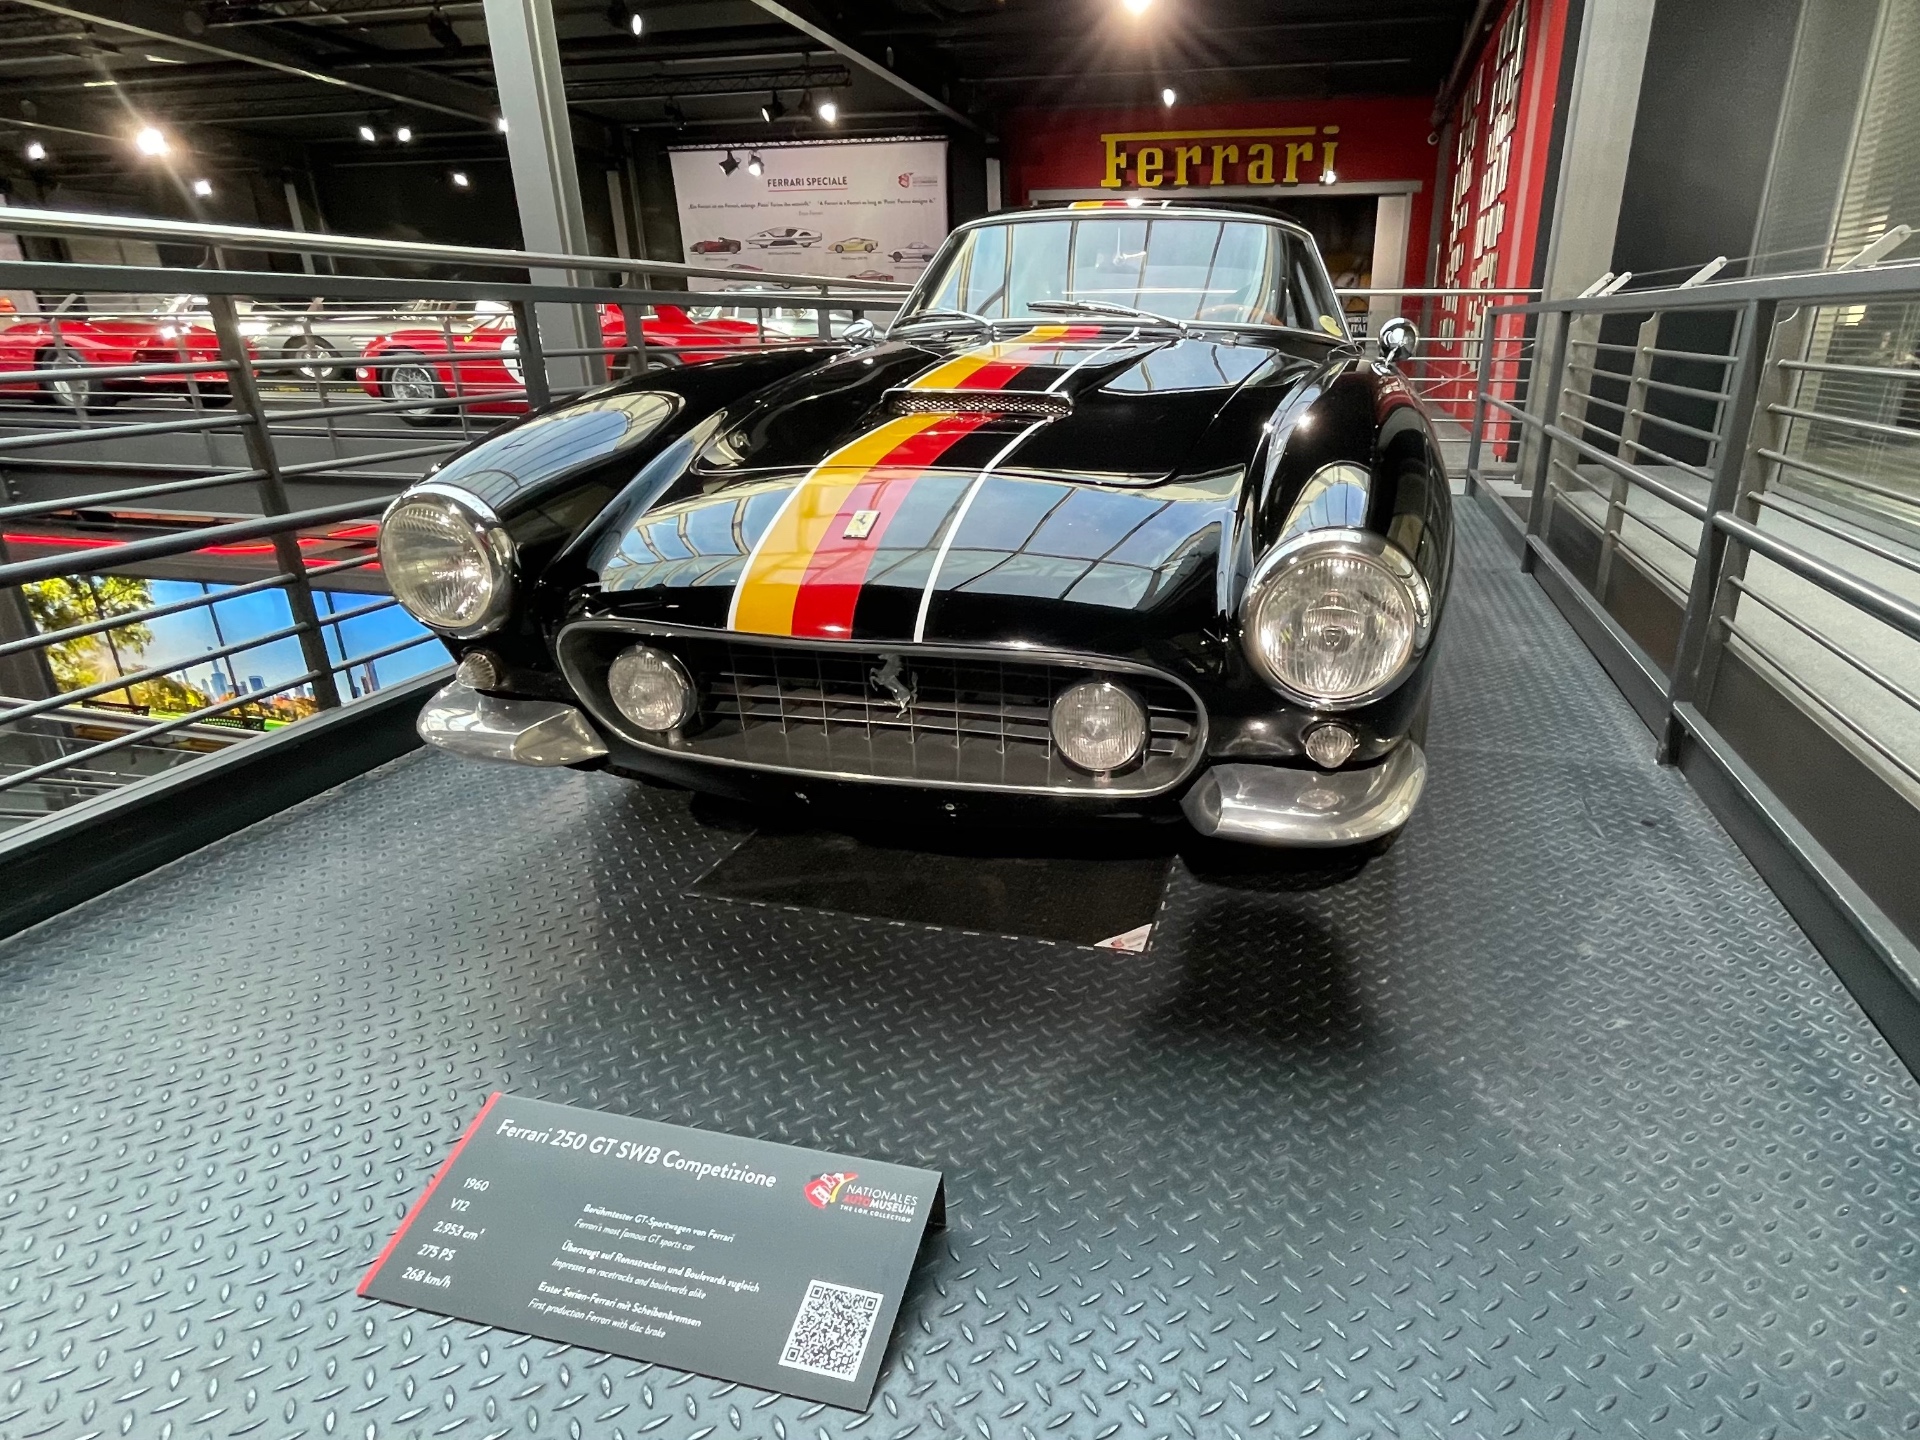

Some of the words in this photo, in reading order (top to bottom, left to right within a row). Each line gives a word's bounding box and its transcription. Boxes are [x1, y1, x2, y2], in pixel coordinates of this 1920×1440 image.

[1100, 125, 1340, 188] Ferrari
[767, 178, 805, 188] FERRARI
[806, 176, 848, 186] SPECIALE
[496, 1119, 553, 1144] Ferrari
[550, 1129, 588, 1150] 250
[589, 1136, 618, 1156] GT
[616, 1141, 661, 1165] SWB
[662, 1150, 777, 1188] Competizione
[463, 1177, 490, 1192] 1960
[846, 1184, 918, 1206] NATIONALES
[450, 1198, 471, 1212] V12
[840, 1204, 853, 1213] THE
[869, 1210, 912, 1223] COLLECTION
[432, 1220, 464, 1237] 2.953
[583, 1203, 634, 1222] Berühmtester
[634, 1213, 692, 1235] GT-Sportwagen
[692, 1228, 707, 1237] von
[707, 1228, 736, 1243] Ferrari
[603, 1226, 621, 1237] most
[618, 1227, 647, 1242] famous
[648, 1233, 662, 1244] GT
[659, 1238, 682, 1249] sports
[682, 1243, 696, 1252] car
[417, 1244, 440, 1258] 275
[438, 1248, 457, 1261] PS
[402, 1267, 425, 1282] 268
[423, 1271, 451, 1289] km/h
[561, 1239, 600, 1260] Überzeugt
[600, 1251, 616, 1261] auf
[613, 1251, 667, 1273] Rennstrecken
[667, 1266, 685, 1277] und
[684, 1267, 727, 1286] Boulevards
[727, 1280, 760, 1293] zugleich
[551, 1257, 586, 1271] Impresses
[597, 1270, 634, 1284] racetracks
[634, 1276, 651, 1287] and
[649, 1279, 688, 1296] boulevards
[688, 1287, 707, 1300] alike
[538, 1281, 562, 1295] Erster
[562, 1287, 619, 1308] Serien-Ferrari
[616, 1301, 632, 1312] mit
[631, 1302, 702, 1328] Scheibenbremsen
[527, 1297, 547, 1310] First
[543, 1304, 586, 1320] production
[585, 1310, 614, 1325] Ferrari
[611, 1317, 629, 1330] with
[628, 1321, 645, 1333] disc
[644, 1323, 667, 1339] brake
